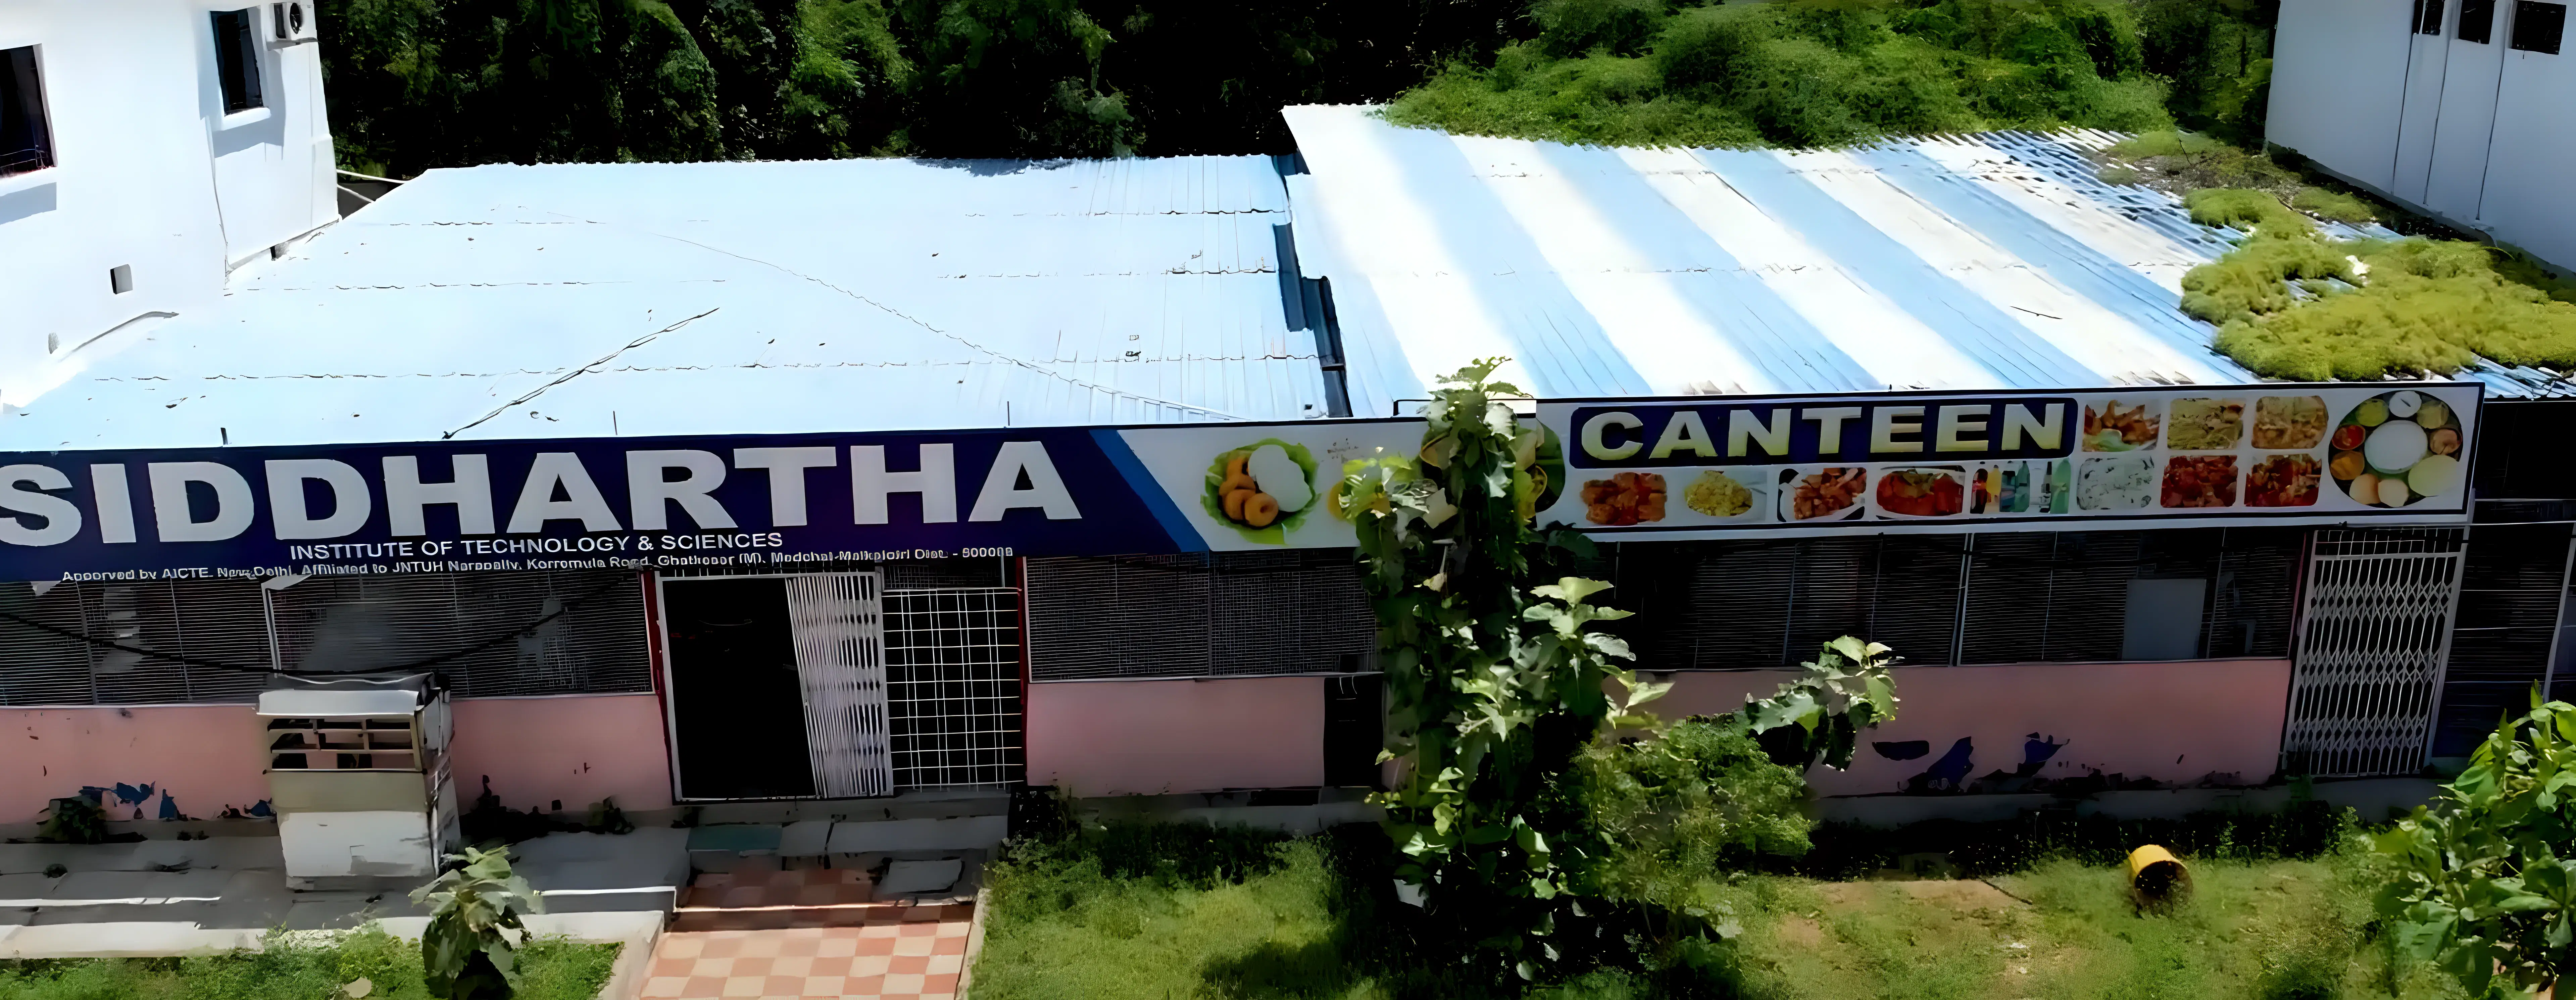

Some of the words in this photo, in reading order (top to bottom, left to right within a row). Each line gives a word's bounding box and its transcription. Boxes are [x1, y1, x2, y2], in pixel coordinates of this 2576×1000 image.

[1581, 403, 2065, 460] CANTEEN
[0, 441, 1083, 547] SIDDHARTHA
[290, 542, 413, 560] INSTITUTE
[421, 541, 452, 556] OF
[460, 536, 630, 555] TECHNOLOGY
[638, 536, 654, 551] &
[661, 533, 783, 550] SCIENCES
[392, 561, 443, 573] JNTUH
